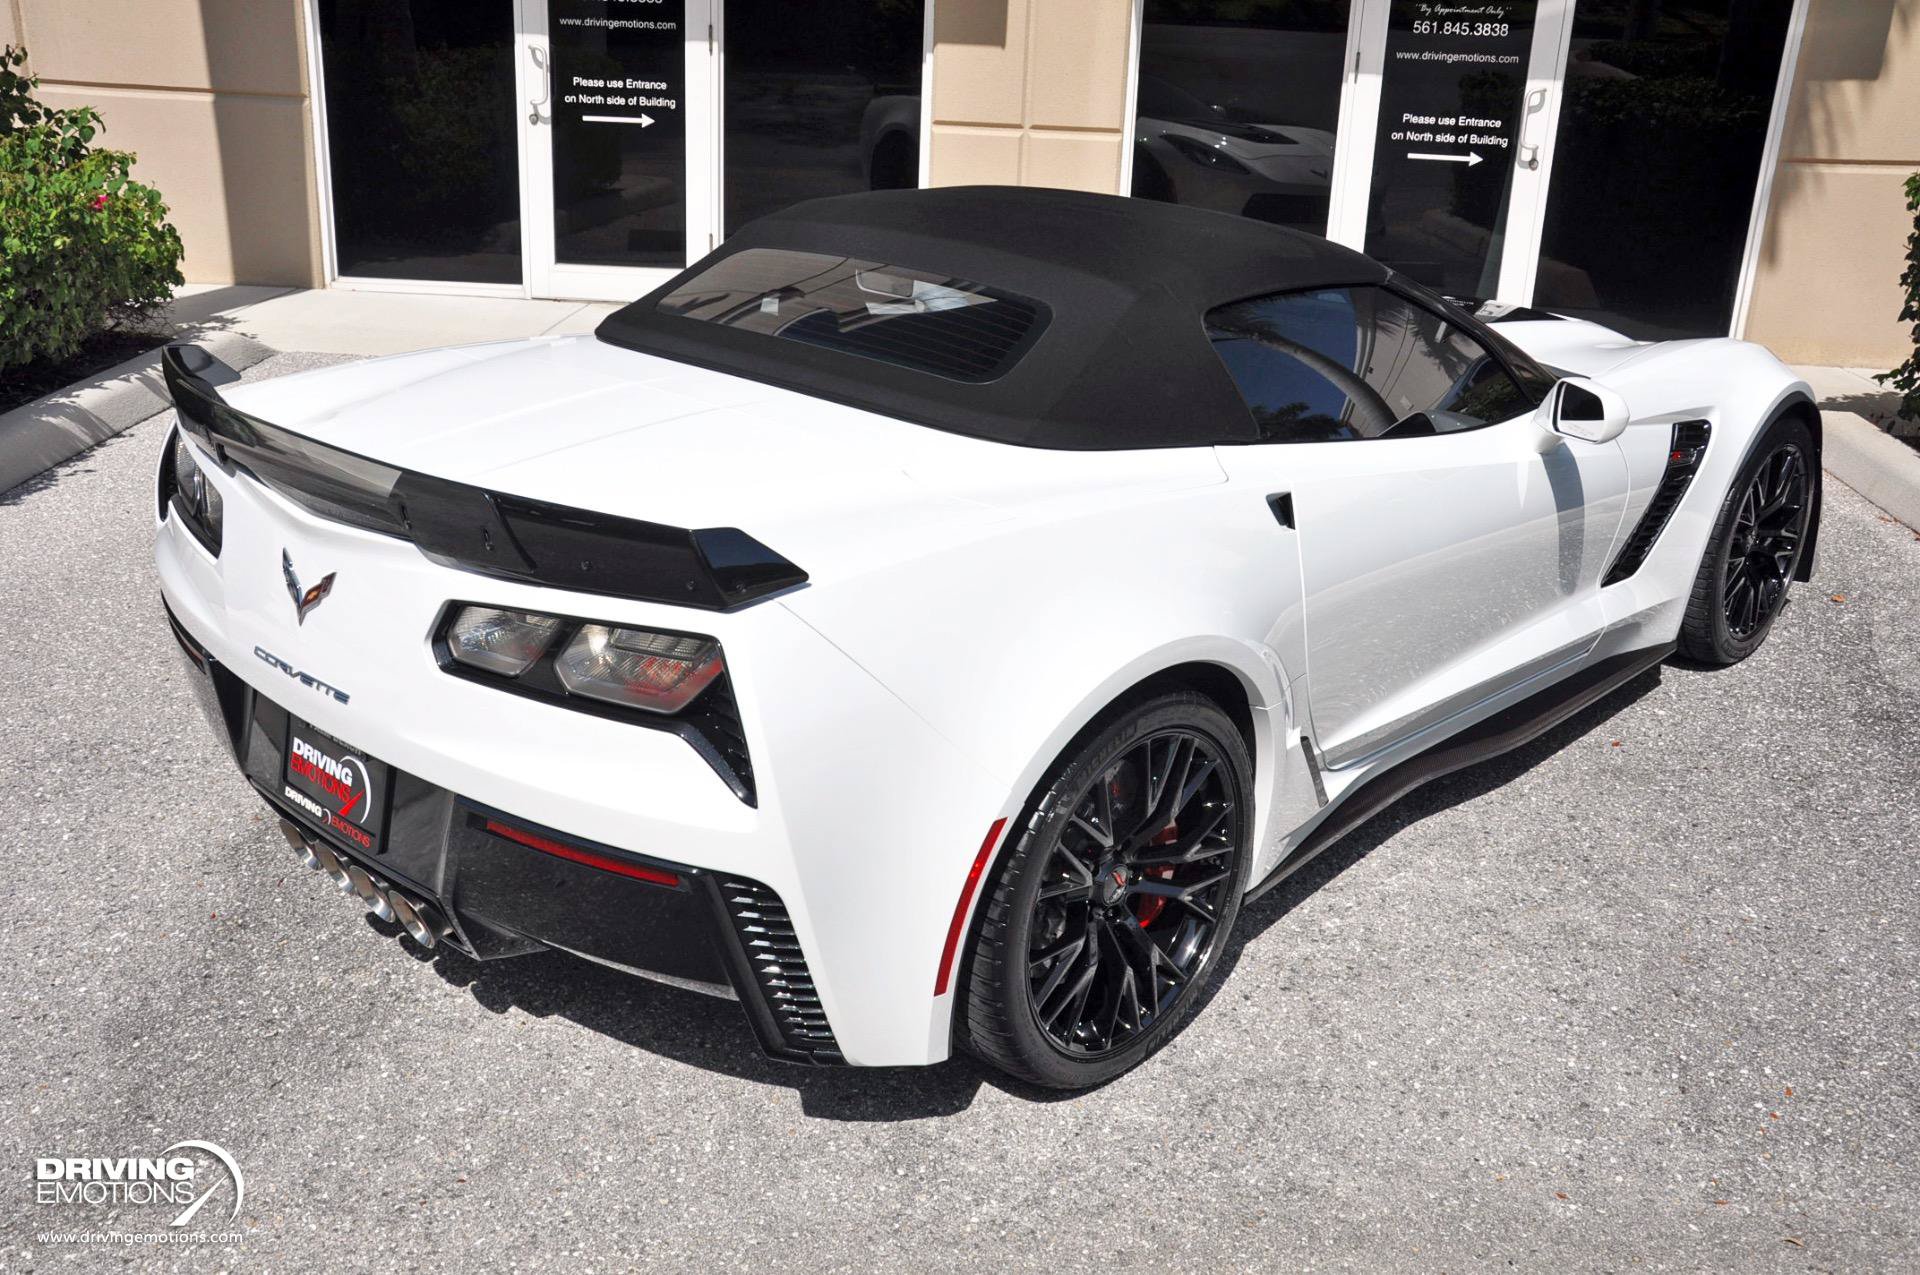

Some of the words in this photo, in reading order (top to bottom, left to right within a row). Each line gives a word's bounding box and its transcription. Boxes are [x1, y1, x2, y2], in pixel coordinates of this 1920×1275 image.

[1434, 4, 1485, 16] Appointment
[559, 17, 677, 30] www.drivingemotions.com
[1413, 20, 1509, 37] 561.845.3838
[1396, 50, 1519, 64] www.drivingemotions.com
[573, 76, 604, 88] Please
[606, 79, 624, 89] use
[626, 78, 667, 90] Entrance
[564, 95, 577, 103] on
[578, 94, 605, 105] North
[606, 95, 626, 106] side
[627, 96, 638, 106] of
[639, 96, 676, 109] Building
[1402, 113, 1436, 125] Please
[1438, 117, 1456, 126] use
[1458, 116, 1502, 128] Entrance
[1391, 132, 1404, 140] on
[1406, 131, 1433, 142] North
[1435, 132, 1455, 143] side
[1457, 133, 1468, 143] of
[1469, 134, 1508, 148] Building
[254, 645, 350, 705] CORVETTE
[293, 736, 353, 787] DRIVING
[291, 751, 352, 804] EMOTIONS
[284, 786, 323, 818] DRIVING
[331, 815, 371, 848] EMOTIONS
